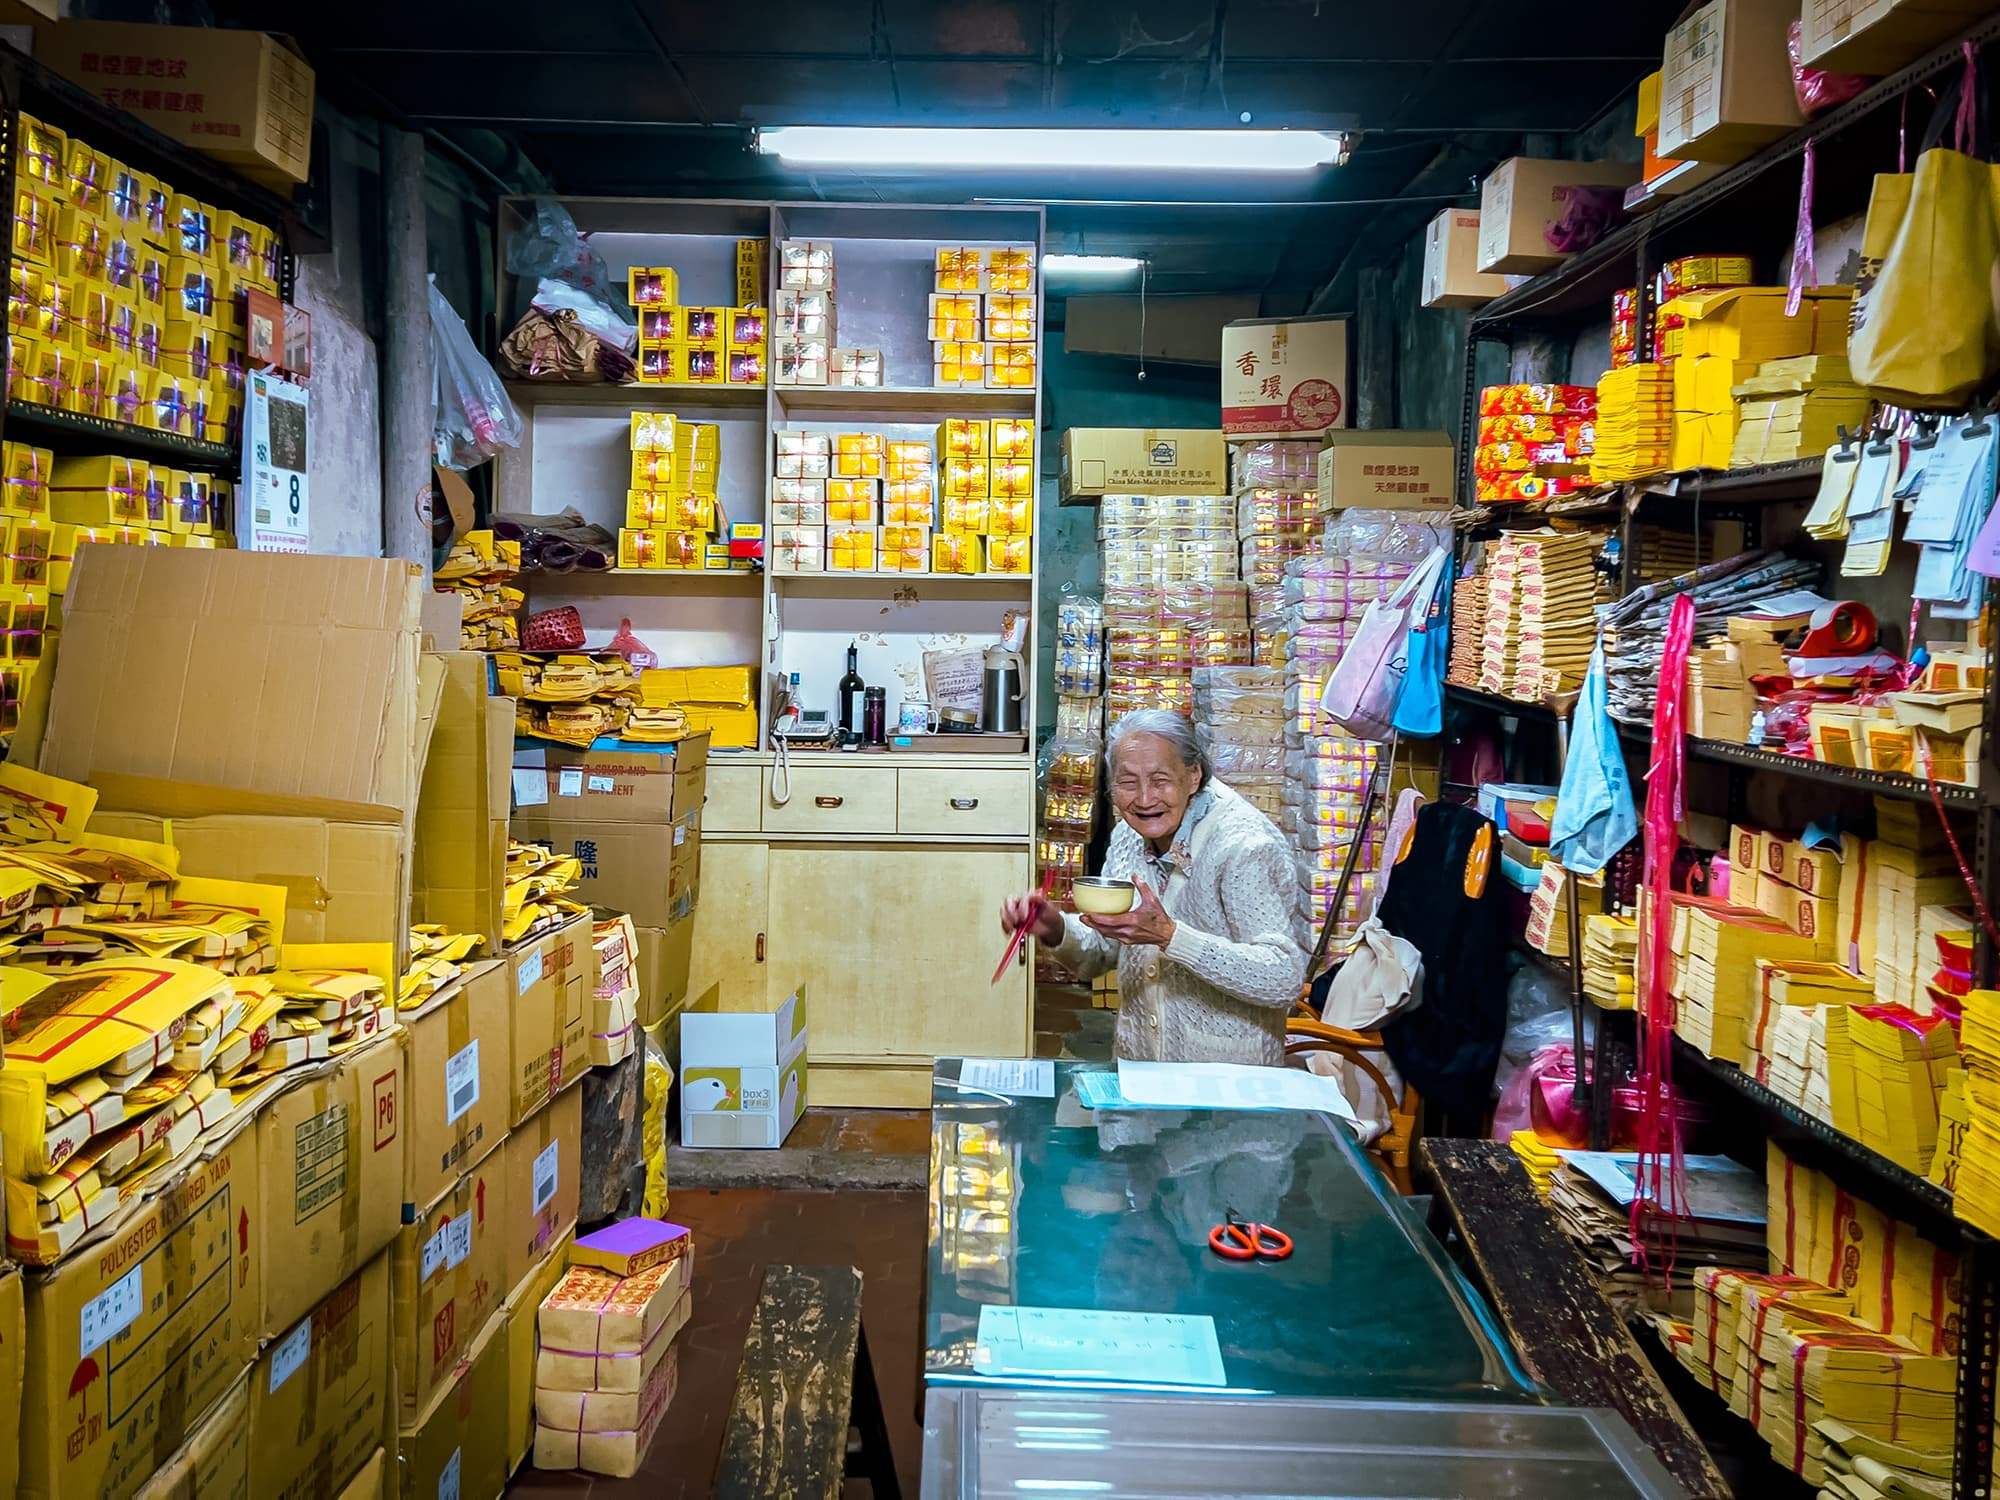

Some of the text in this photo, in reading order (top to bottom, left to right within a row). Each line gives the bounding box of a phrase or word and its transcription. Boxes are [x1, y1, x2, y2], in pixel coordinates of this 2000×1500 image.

[289, 474, 300, 514] 8
[379, 1091, 394, 1129] P6
[743, 1089, 769, 1099] box3
[100, 1217, 158, 1281] POLYESTER
[209, 1153, 232, 1185] YARN
[66, 1410, 103, 1464] KEEP DRY
